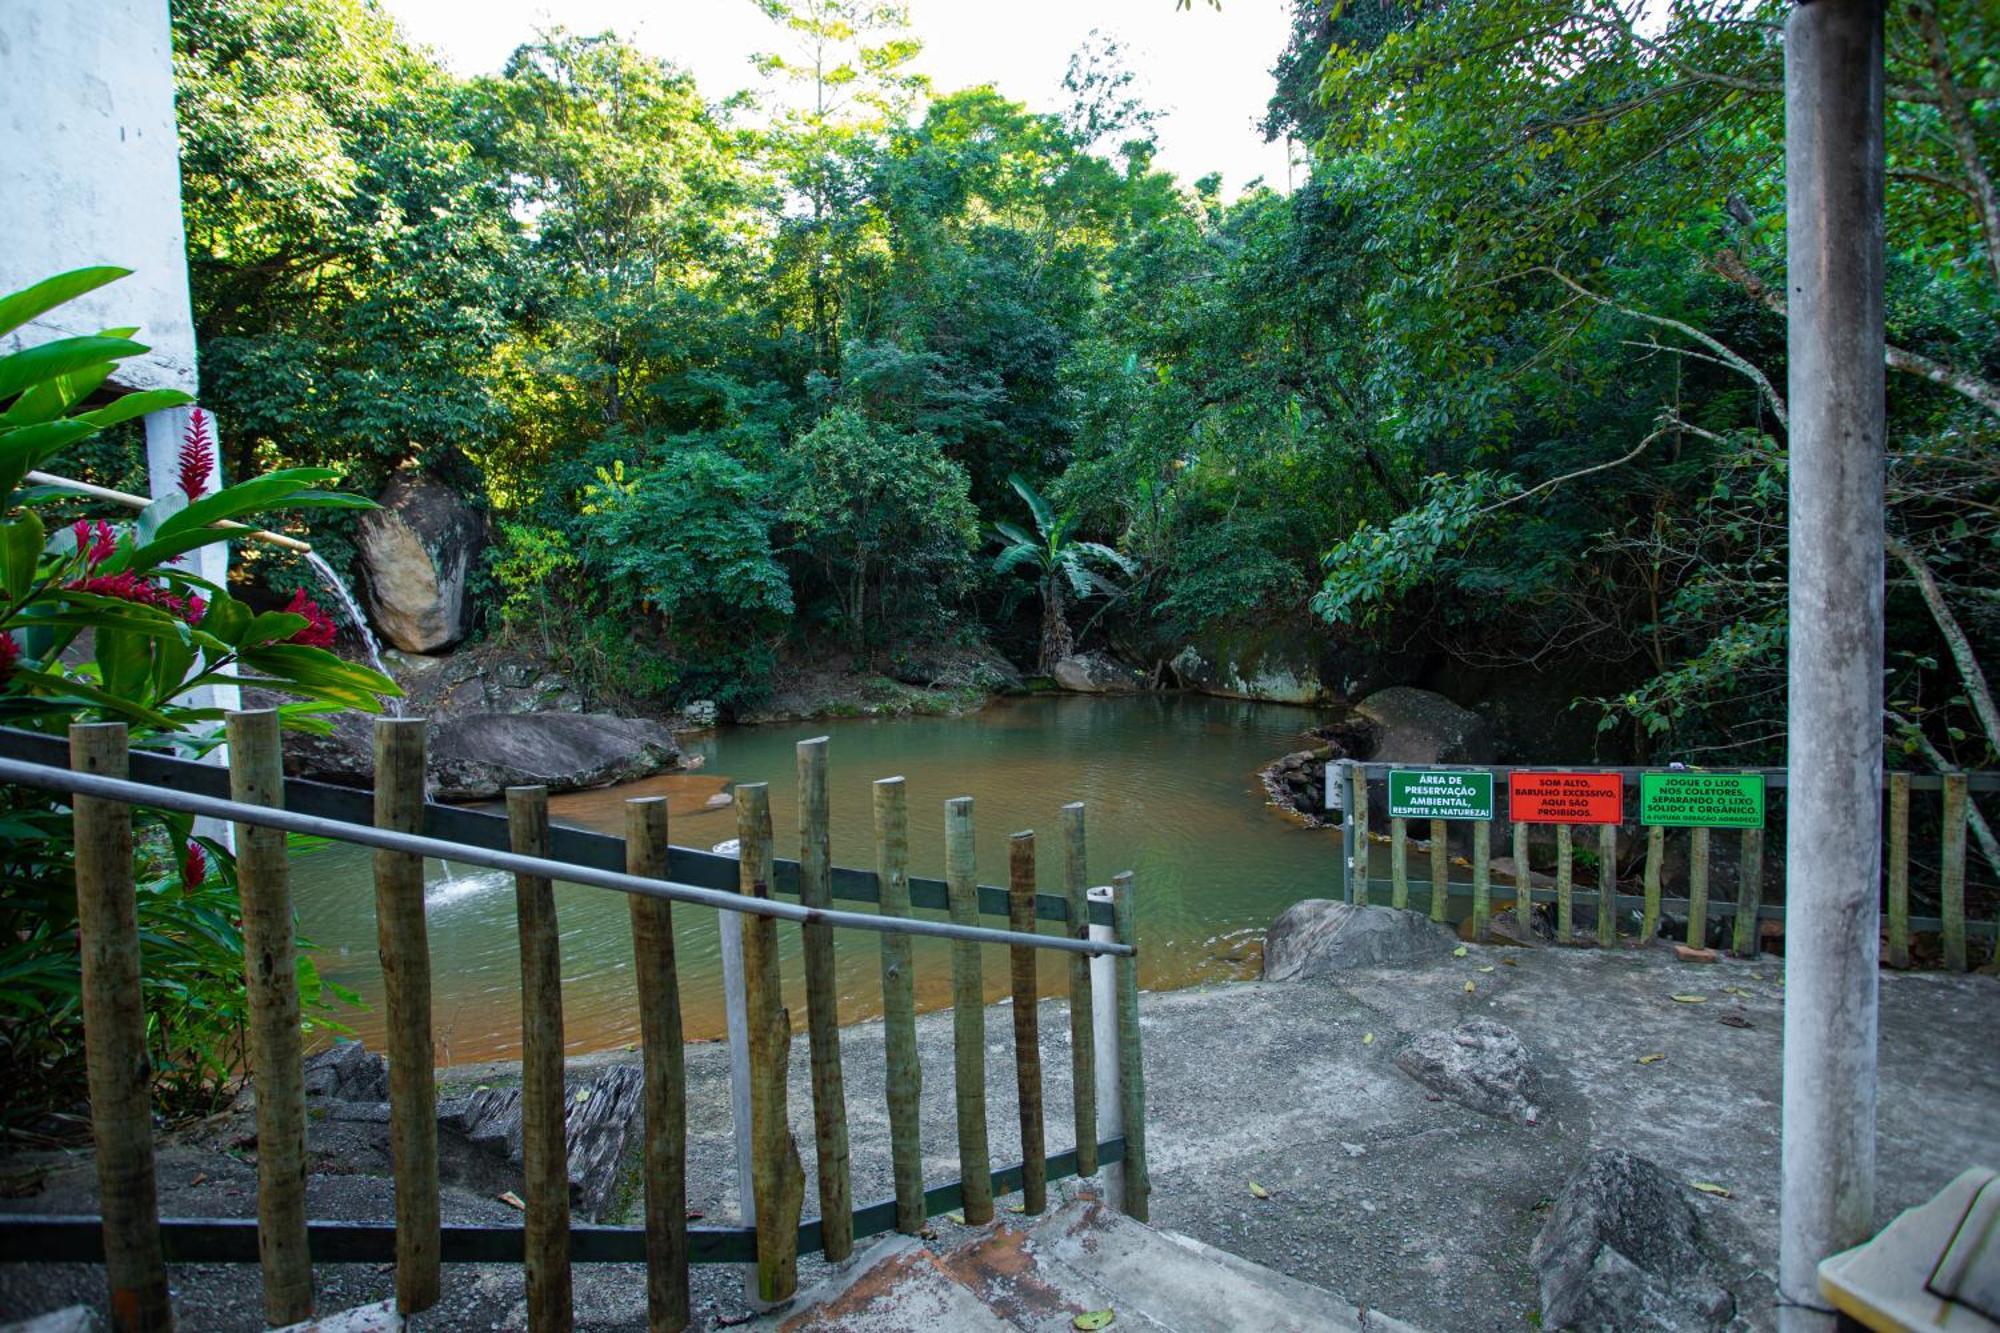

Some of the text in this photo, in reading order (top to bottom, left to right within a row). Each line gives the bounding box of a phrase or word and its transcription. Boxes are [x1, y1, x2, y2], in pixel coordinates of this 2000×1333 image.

[1419, 774, 1462, 785] ÁREA DE
[1539, 779, 1590, 788] SOM ALTO,
[1665, 778, 1739, 788] JOGUE O LIXO
[1404, 785, 1477, 798] PRESERVAÇÃO
[1515, 788, 1560, 796] BARULHO
[1660, 787, 1682, 795] NOS
[1410, 797, 1472, 808] AMBIENTAL,
[1541, 799, 1566, 807] AQUI
[1652, 796, 1753, 806] SEPARANDO O LIXO
[1393, 807, 1430, 815] RESPEITE
[1440, 808, 1489, 817] NATUREZA!
[1688, 805, 1695, 813] E
